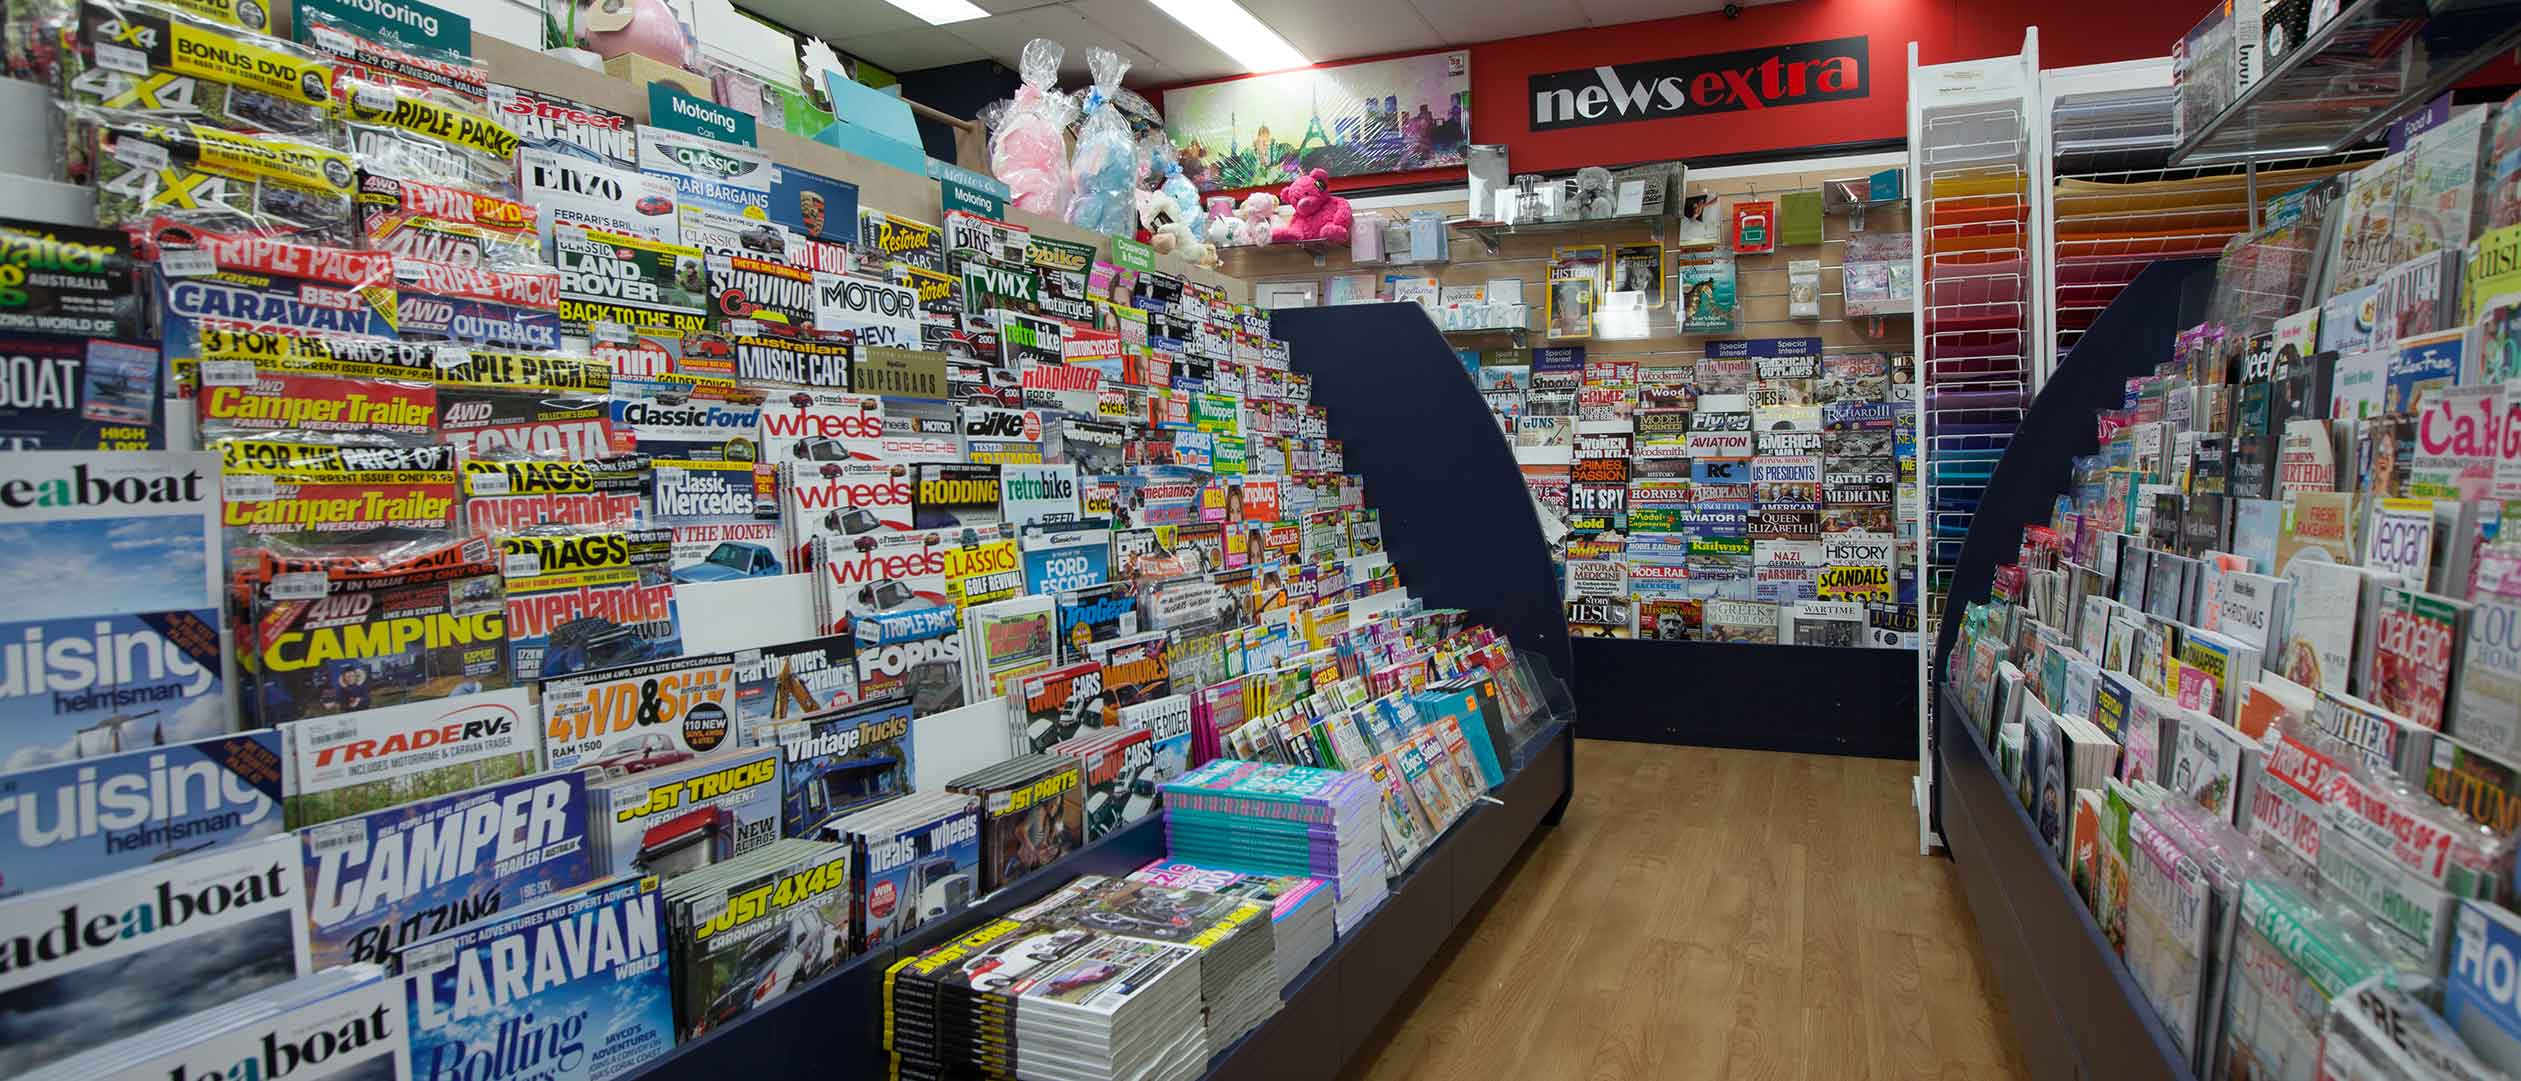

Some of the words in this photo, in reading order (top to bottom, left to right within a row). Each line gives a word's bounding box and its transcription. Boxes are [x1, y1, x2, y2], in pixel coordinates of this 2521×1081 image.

[379, 25, 400, 41] 4x4
[177, 38, 254, 70] BONUS
[257, 57, 298, 82] DVD
[399, 62, 451, 87] AWESOME
[1536, 65, 1685, 123] news
[1690, 55, 1859, 111] extra
[505, 96, 624, 131] Street
[672, 97, 735, 132] Motoring
[382, 100, 453, 137] TRIPLE
[458, 117, 518, 156] PACK!
[697, 126, 715, 140] Cars
[676, 147, 739, 176] CLASSIC
[401, 180, 474, 222] TWIN
[705, 181, 769, 210] BARGAINS
[955, 189, 992, 211] Motoring
[554, 209, 609, 228] FERRARI'S
[684, 230, 737, 249] CLASSIC
[880, 225, 928, 253] Restored
[955, 228, 992, 253] BIKE
[559, 252, 639, 280] LAND
[820, 243, 847, 274] ROD
[905, 253, 931, 270] CARS
[28, 273, 109, 291] AUSTRALIA
[560, 271, 658, 302] ROVER
[982, 267, 1032, 300] VMX
[302, 286, 362, 308] BEST
[822, 281, 914, 319] MOTOR
[172, 283, 369, 334] CARAVAN
[400, 300, 453, 322] 4WD
[560, 303, 609, 322] BACK
[612, 307, 635, 324] TO
[637, 310, 670, 327] THE
[38, 316, 90, 331] WORLD
[454, 315, 555, 345] OUTBACK
[1244, 316, 1270, 327] CODE
[232, 333, 279, 354] FOR
[331, 341, 395, 364] PRICE
[400, 345, 425, 366] OF
[737, 336, 847, 354] Australian
[1064, 337, 1120, 356] MOTORCYCLIST
[1546, 350, 1571, 358] Special
[1777, 340, 1806, 348] Special
[281, 361, 340, 373] CURRENT
[343, 364, 374, 375] ISSUE!
[376, 366, 404, 377] ONLY
[740, 349, 807, 386] MUSCLE
[810, 355, 848, 388] CAR
[857, 368, 937, 394] SUPERCARS
[1026, 390, 1044, 400] GOD
[1651, 388, 1684, 397] Wood
[1749, 391, 1777, 408] SPIES
[1099, 402, 1127, 414] CYCLE
[1199, 401, 1235, 418] Whopper
[232, 418, 289, 430] FAMILY
[299, 421, 367, 431] WEEKEND
[764, 405, 881, 439] wheels
[1523, 418, 1554, 429] GUNS
[1641, 415, 1682, 424] MODEL
[101, 428, 146, 440] HIGH
[445, 421, 609, 461] TOYOTA
[1582, 437, 1626, 449] WOMEN
[1691, 436, 1747, 448] AVIATION
[1759, 435, 1822, 449] AMERICA
[1572, 470, 1626, 481] PASSION
[1708, 464, 1732, 477] RC
[1753, 468, 1763, 480] US
[1766, 466, 1815, 481] PRESIDENTS
[796, 477, 911, 509] wheels
[921, 480, 999, 504] RODDING
[1007, 470, 1072, 501] retrobike
[1144, 482, 1197, 500] mechanics
[1632, 489, 1685, 499] HORNBY
[1825, 490, 1890, 503] MEDICINE
[657, 484, 752, 516] Mercedes
[1572, 490, 1595, 509] EYE
[1598, 488, 1624, 509] SPY
[1681, 514, 1735, 523] AVIATOR
[1748, 523, 1805, 534] ELIZABETH
[1762, 513, 1800, 524] QUEEN
[727, 523, 776, 542] MONEY!
[1693, 541, 1749, 553] Railways
[1774, 552, 1800, 561] NAZI
[1826, 545, 1888, 560] HISTORY
[944, 543, 1016, 580] CLASSICS
[1046, 557, 1088, 576] FORD
[1576, 563, 1618, 572] NATURAL
[965, 576, 987, 597] GOLF
[987, 571, 1022, 591] REVIVAL
[1630, 568, 1663, 578] MODEL
[1664, 568, 1686, 578] RAIL
[1758, 569, 1807, 581] WARSHIPS
[1820, 568, 1889, 588] SCANDALS
[308, 594, 373, 619] 4WD
[1569, 604, 1625, 624] JESUS
[1718, 604, 1767, 616] GREEK
[1803, 605, 1855, 616] WARTIME
[881, 614, 925, 638] TRIPLE
[264, 611, 504, 672] CAMPING
[1167, 641, 1186, 660] MY
[858, 637, 962, 680] FORDS
[1072, 672, 1101, 699] CARS
[54, 683, 184, 715] helmsman
[684, 719, 698, 731] 110
[700, 718, 727, 731] NEW
[1163, 710, 1189, 736] RIDER
[349, 760, 388, 777] INCLUDES
[391, 752, 440, 770] MOTORHOME
[450, 742, 483, 759] CARAVAN
[485, 736, 512, 751] TRADER
[552, 743, 576, 760] RAM
[578, 740, 602, 755] 1500
[687, 757, 777, 804] TRUCKS
[1034, 768, 1079, 801] PARTS
[930, 814, 977, 852] wheels
[311, 779, 571, 928] CAMPER
[494, 852, 540, 879] TRAILER
[697, 882, 773, 942] JUST
[771, 857, 846, 909] 4X4S
[477, 911, 546, 943] ADVENTURES
[567, 894, 602, 916] EXPERT
[602, 886, 636, 906] ADVICE
[709, 920, 773, 952] CARAVANS
[406, 893, 660, 1033] CARAVAN
[614, 956, 660, 982] WORLD
[430, 1010, 589, 1081] Rolling
[591, 1029, 658, 1062] ADVENTURER
